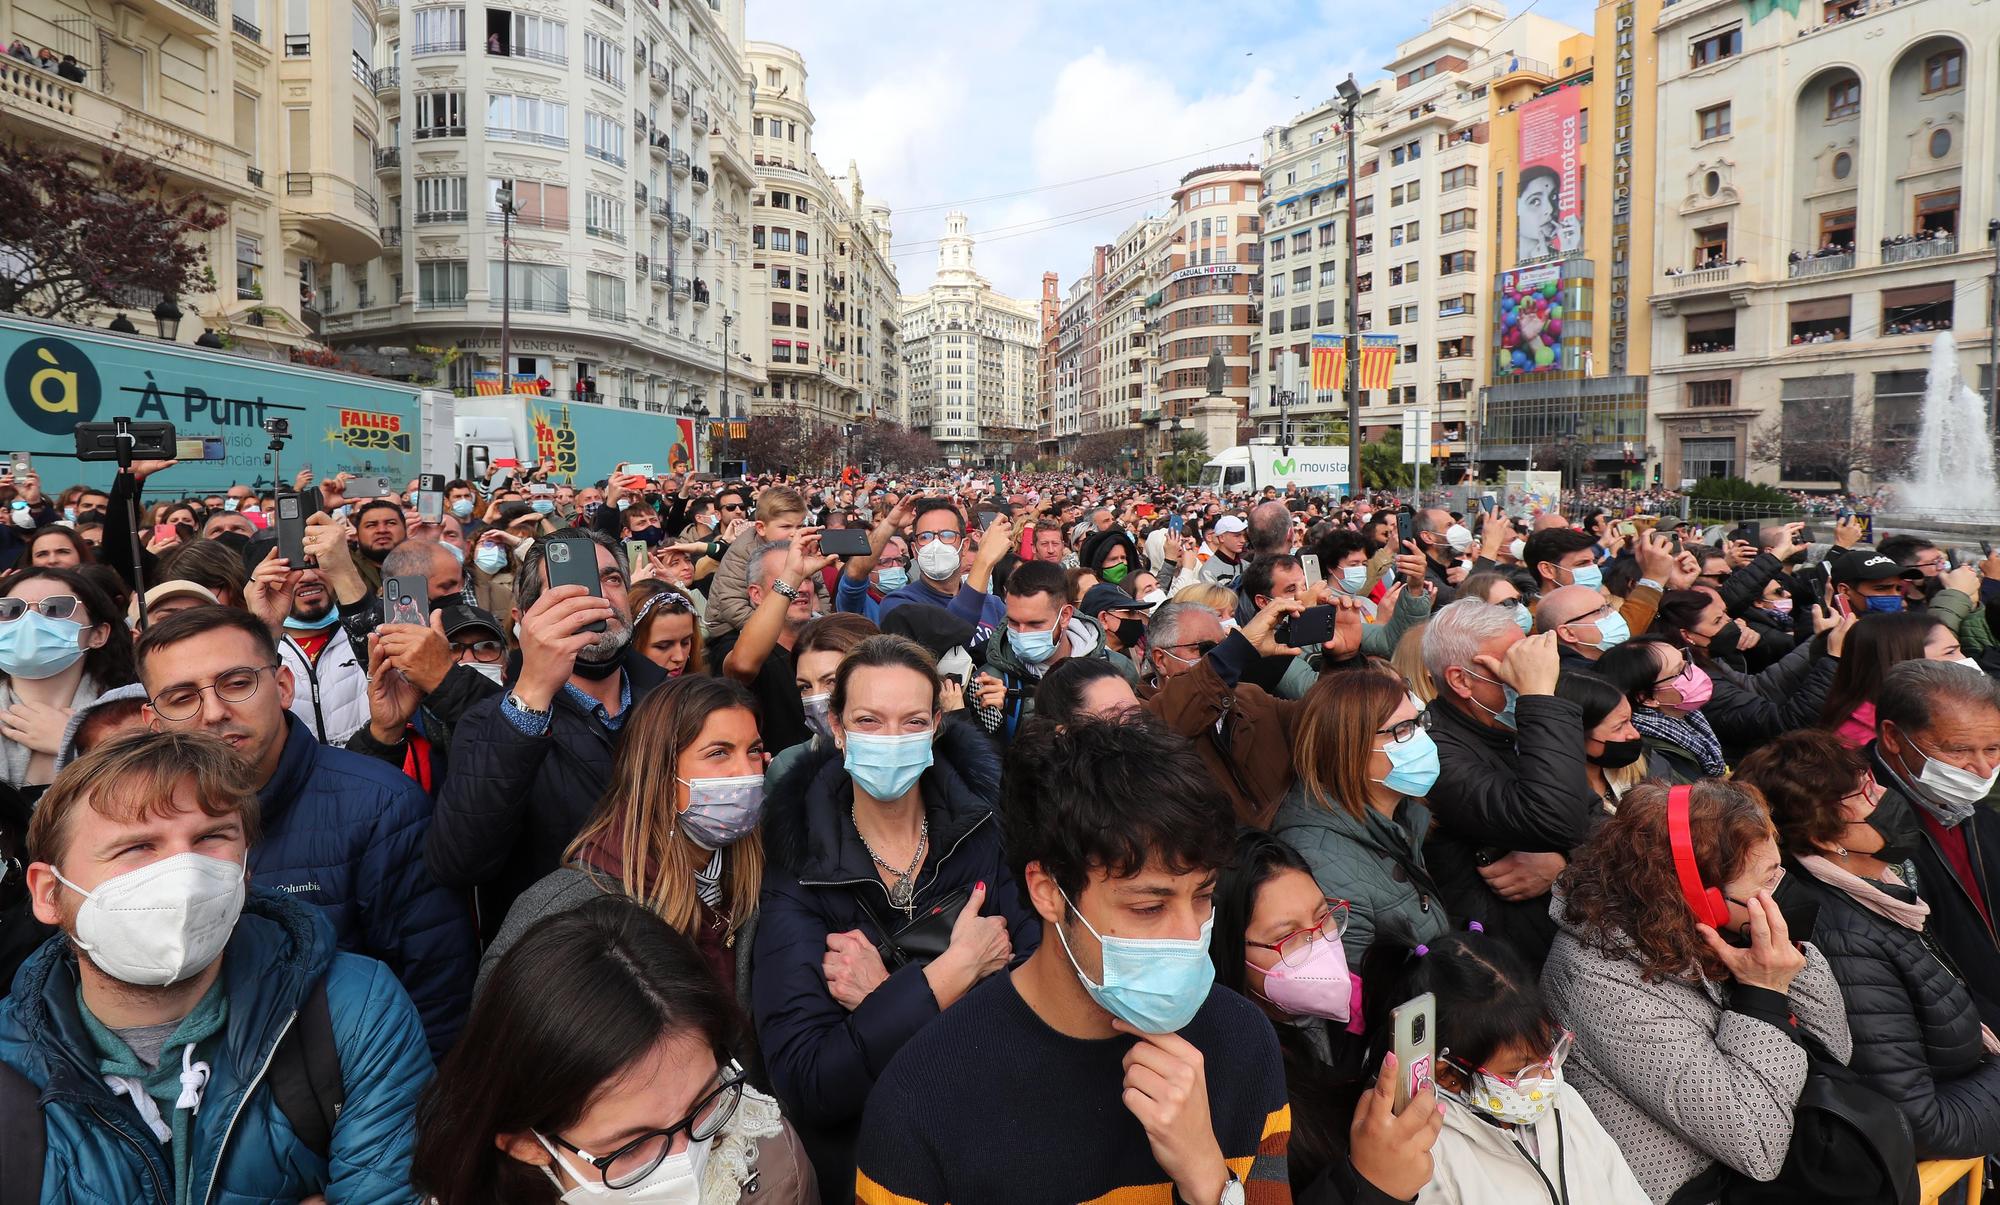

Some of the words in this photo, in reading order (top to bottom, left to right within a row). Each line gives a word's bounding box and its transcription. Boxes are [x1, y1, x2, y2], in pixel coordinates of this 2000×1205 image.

[1616, 15, 1632, 107] RIALTO
[1558, 115, 1576, 215] filmoteca
[1614, 124, 1632, 216] TEATRE
[467, 338, 501, 350] HOTE
[512, 339, 569, 353] VENECIA
[136, 370, 170, 420] À
[184, 386, 268, 428] Punt
[341, 410, 400, 433] FALLES
[348, 427, 390, 450] 22
